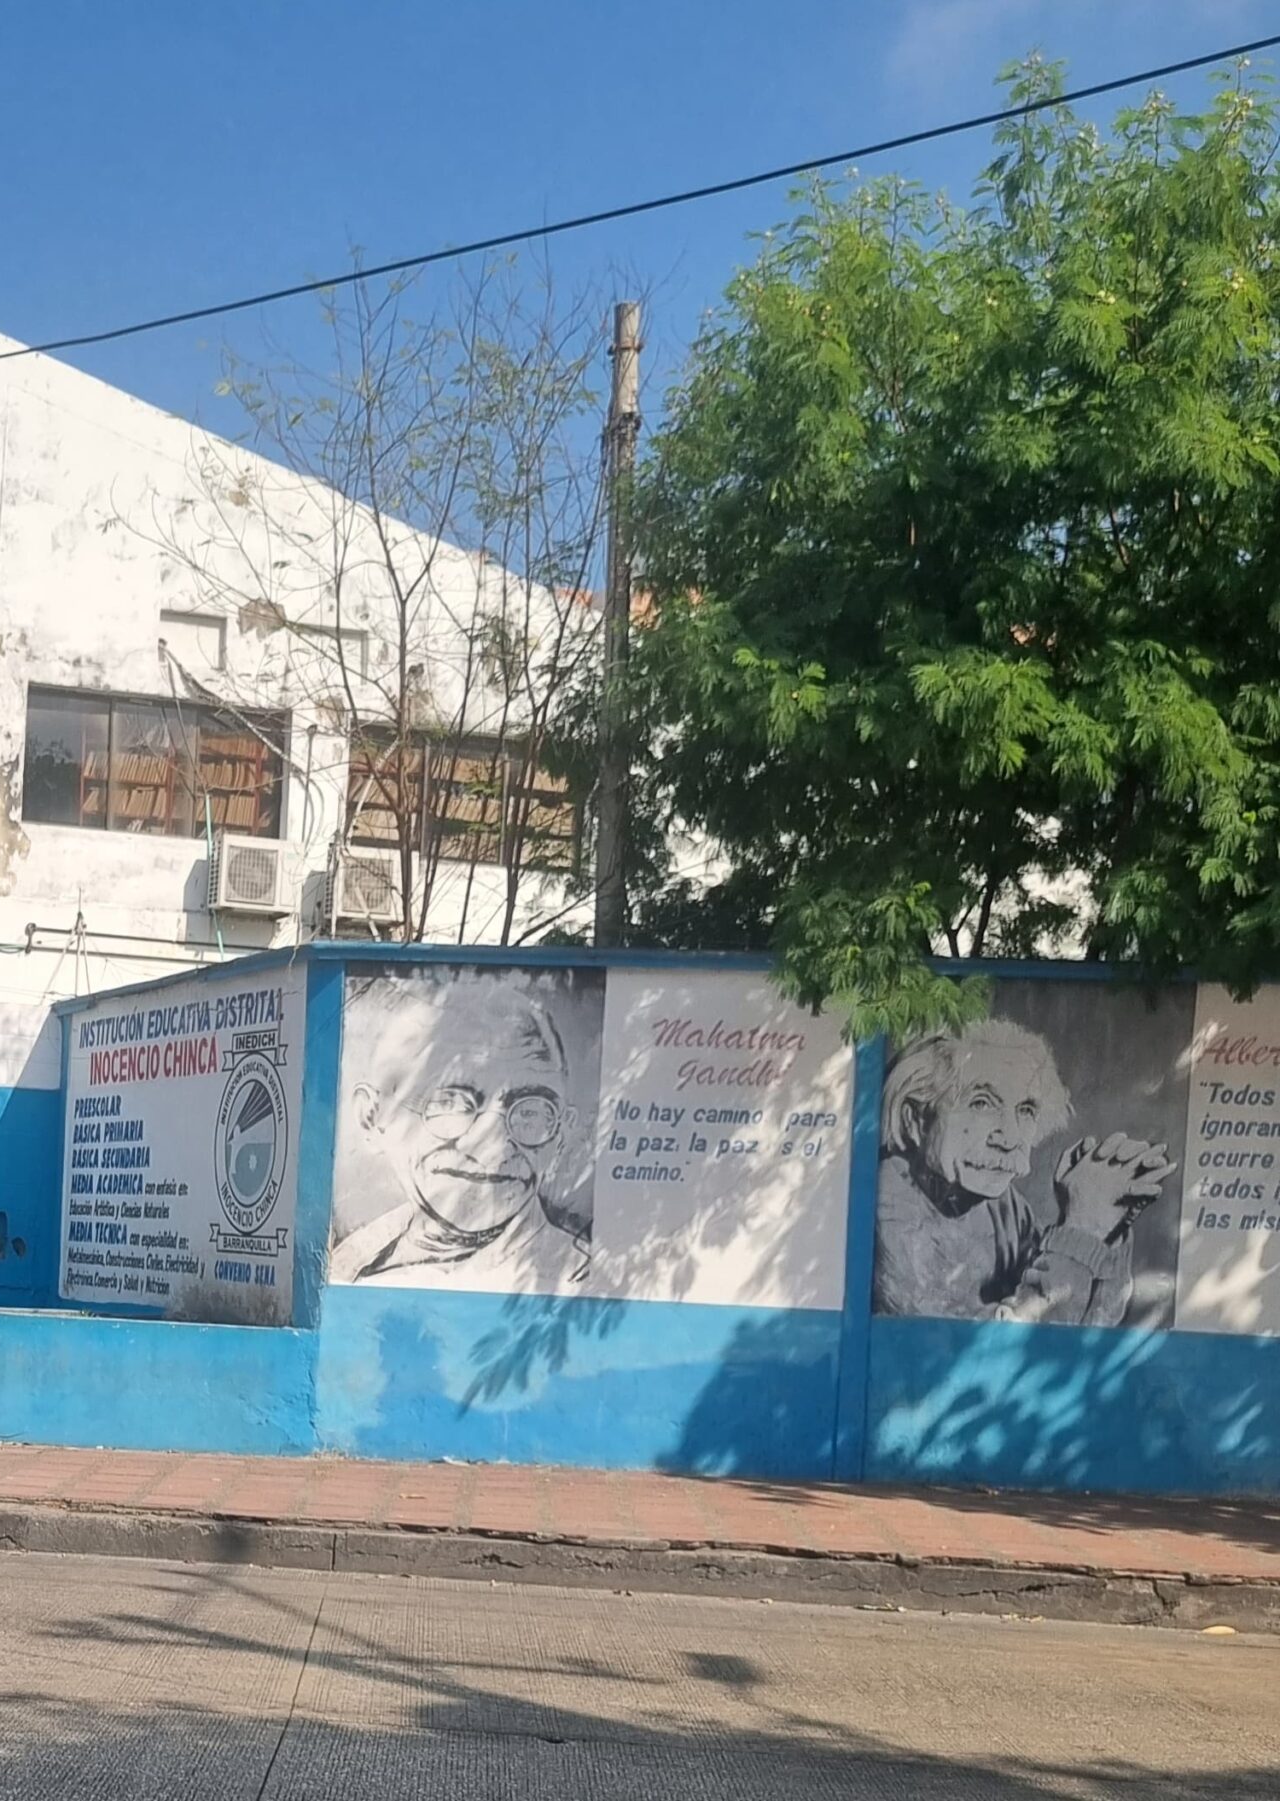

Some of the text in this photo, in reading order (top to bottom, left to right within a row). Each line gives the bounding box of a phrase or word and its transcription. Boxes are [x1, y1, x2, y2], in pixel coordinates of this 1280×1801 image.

[79, 1005, 145, 1049] INSTITUCIÓN
[146, 1002, 211, 1039] EDUCATIVA
[652, 1018, 806, 1051] Mahatma
[235, 1032, 276, 1050] INEDICH
[89, 1044, 160, 1086] INOCENCIO
[74, 1095, 122, 1119] PREESCOLAR
[648, 1101, 686, 1128] hay
[693, 1108, 764, 1125] camino
[785, 1111, 838, 1133] para
[103, 1119, 144, 1142] PRIMARIA
[609, 1129, 628, 1151] la
[688, 1131, 708, 1152] la
[716, 1139, 760, 1159] paz
[803, 1136, 823, 1156] el
[101, 1146, 150, 1169] SECUNDARIA
[1198, 1150, 1275, 1169] ocurre
[71, 1173, 93, 1194] MEDIA
[144, 1183, 156, 1195] con
[1199, 1176, 1265, 1199] todos
[115, 1205, 120, 1220] y
[121, 1201, 142, 1218] Ciencias
[143, 1201, 170, 1219] Naturales
[221, 1181, 254, 1228] INOCENCIO
[1196, 1206, 1231, 1230] las
[69, 1221, 92, 1242] MEDIA
[129, 1232, 140, 1246] con
[141, 1229, 178, 1251] especialidad
[223, 1236, 272, 1252] BARRANQUILLA
[200, 1262, 206, 1280] y
[214, 1259, 276, 1286] CONVENIO SENA
[117, 1278, 123, 1293] y
[123, 1273, 139, 1292] Salud
[140, 1280, 145, 1296] y
